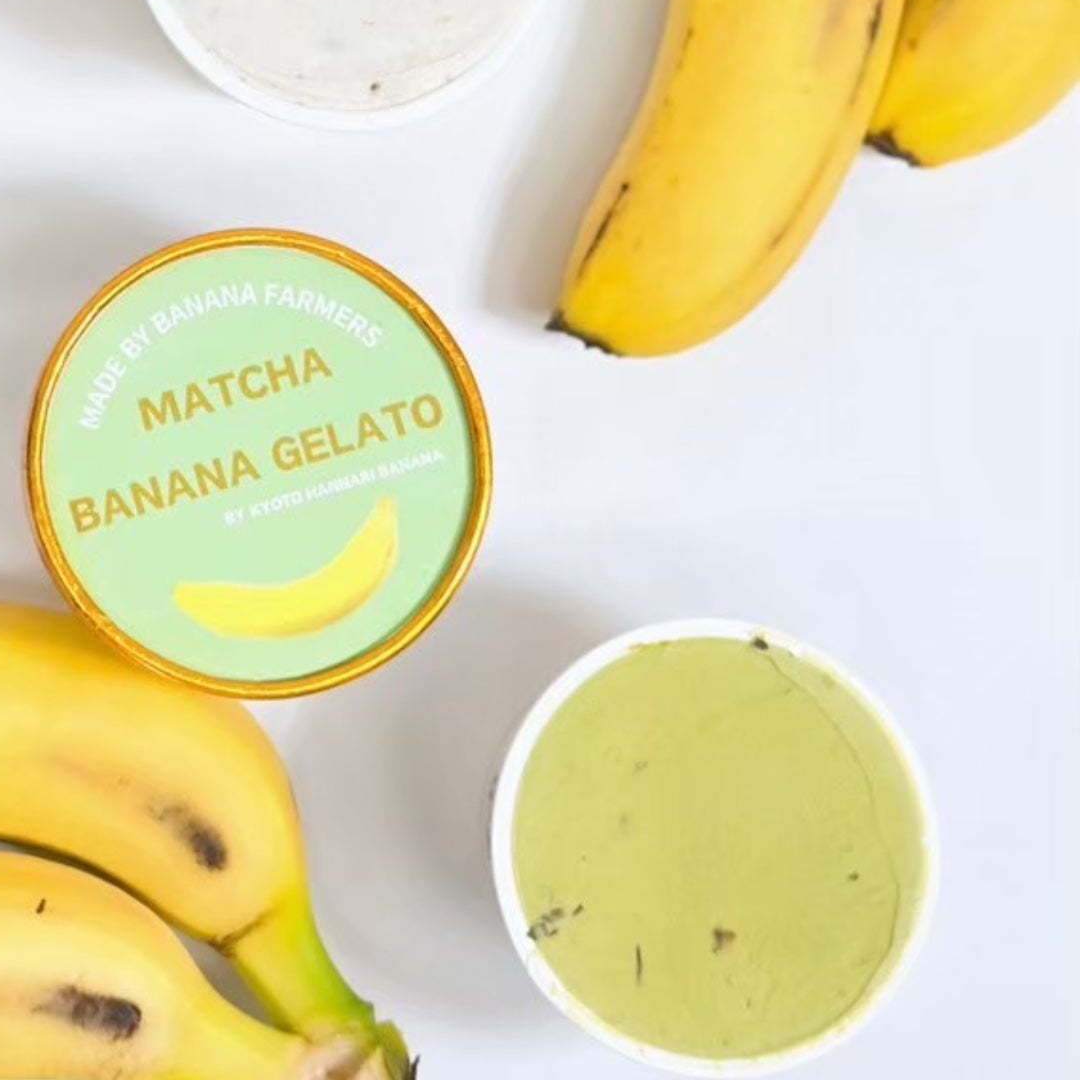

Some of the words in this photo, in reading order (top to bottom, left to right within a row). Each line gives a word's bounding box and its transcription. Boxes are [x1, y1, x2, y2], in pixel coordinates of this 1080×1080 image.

[80, 359, 127, 430] MADE
[120, 329, 152, 360] BY
[152, 282, 257, 334] BANANA
[265, 283, 384, 349] FARMERS
[137, 347, 333, 431] MATCHA
[69, 450, 261, 534] BANANA
[272, 394, 442, 472] GELATO
[224, 509, 244, 526] BY
[249, 491, 303, 518] KYOTO
[306, 470, 376, 502] HANNARI
[379, 450, 444, 481] BANANA
